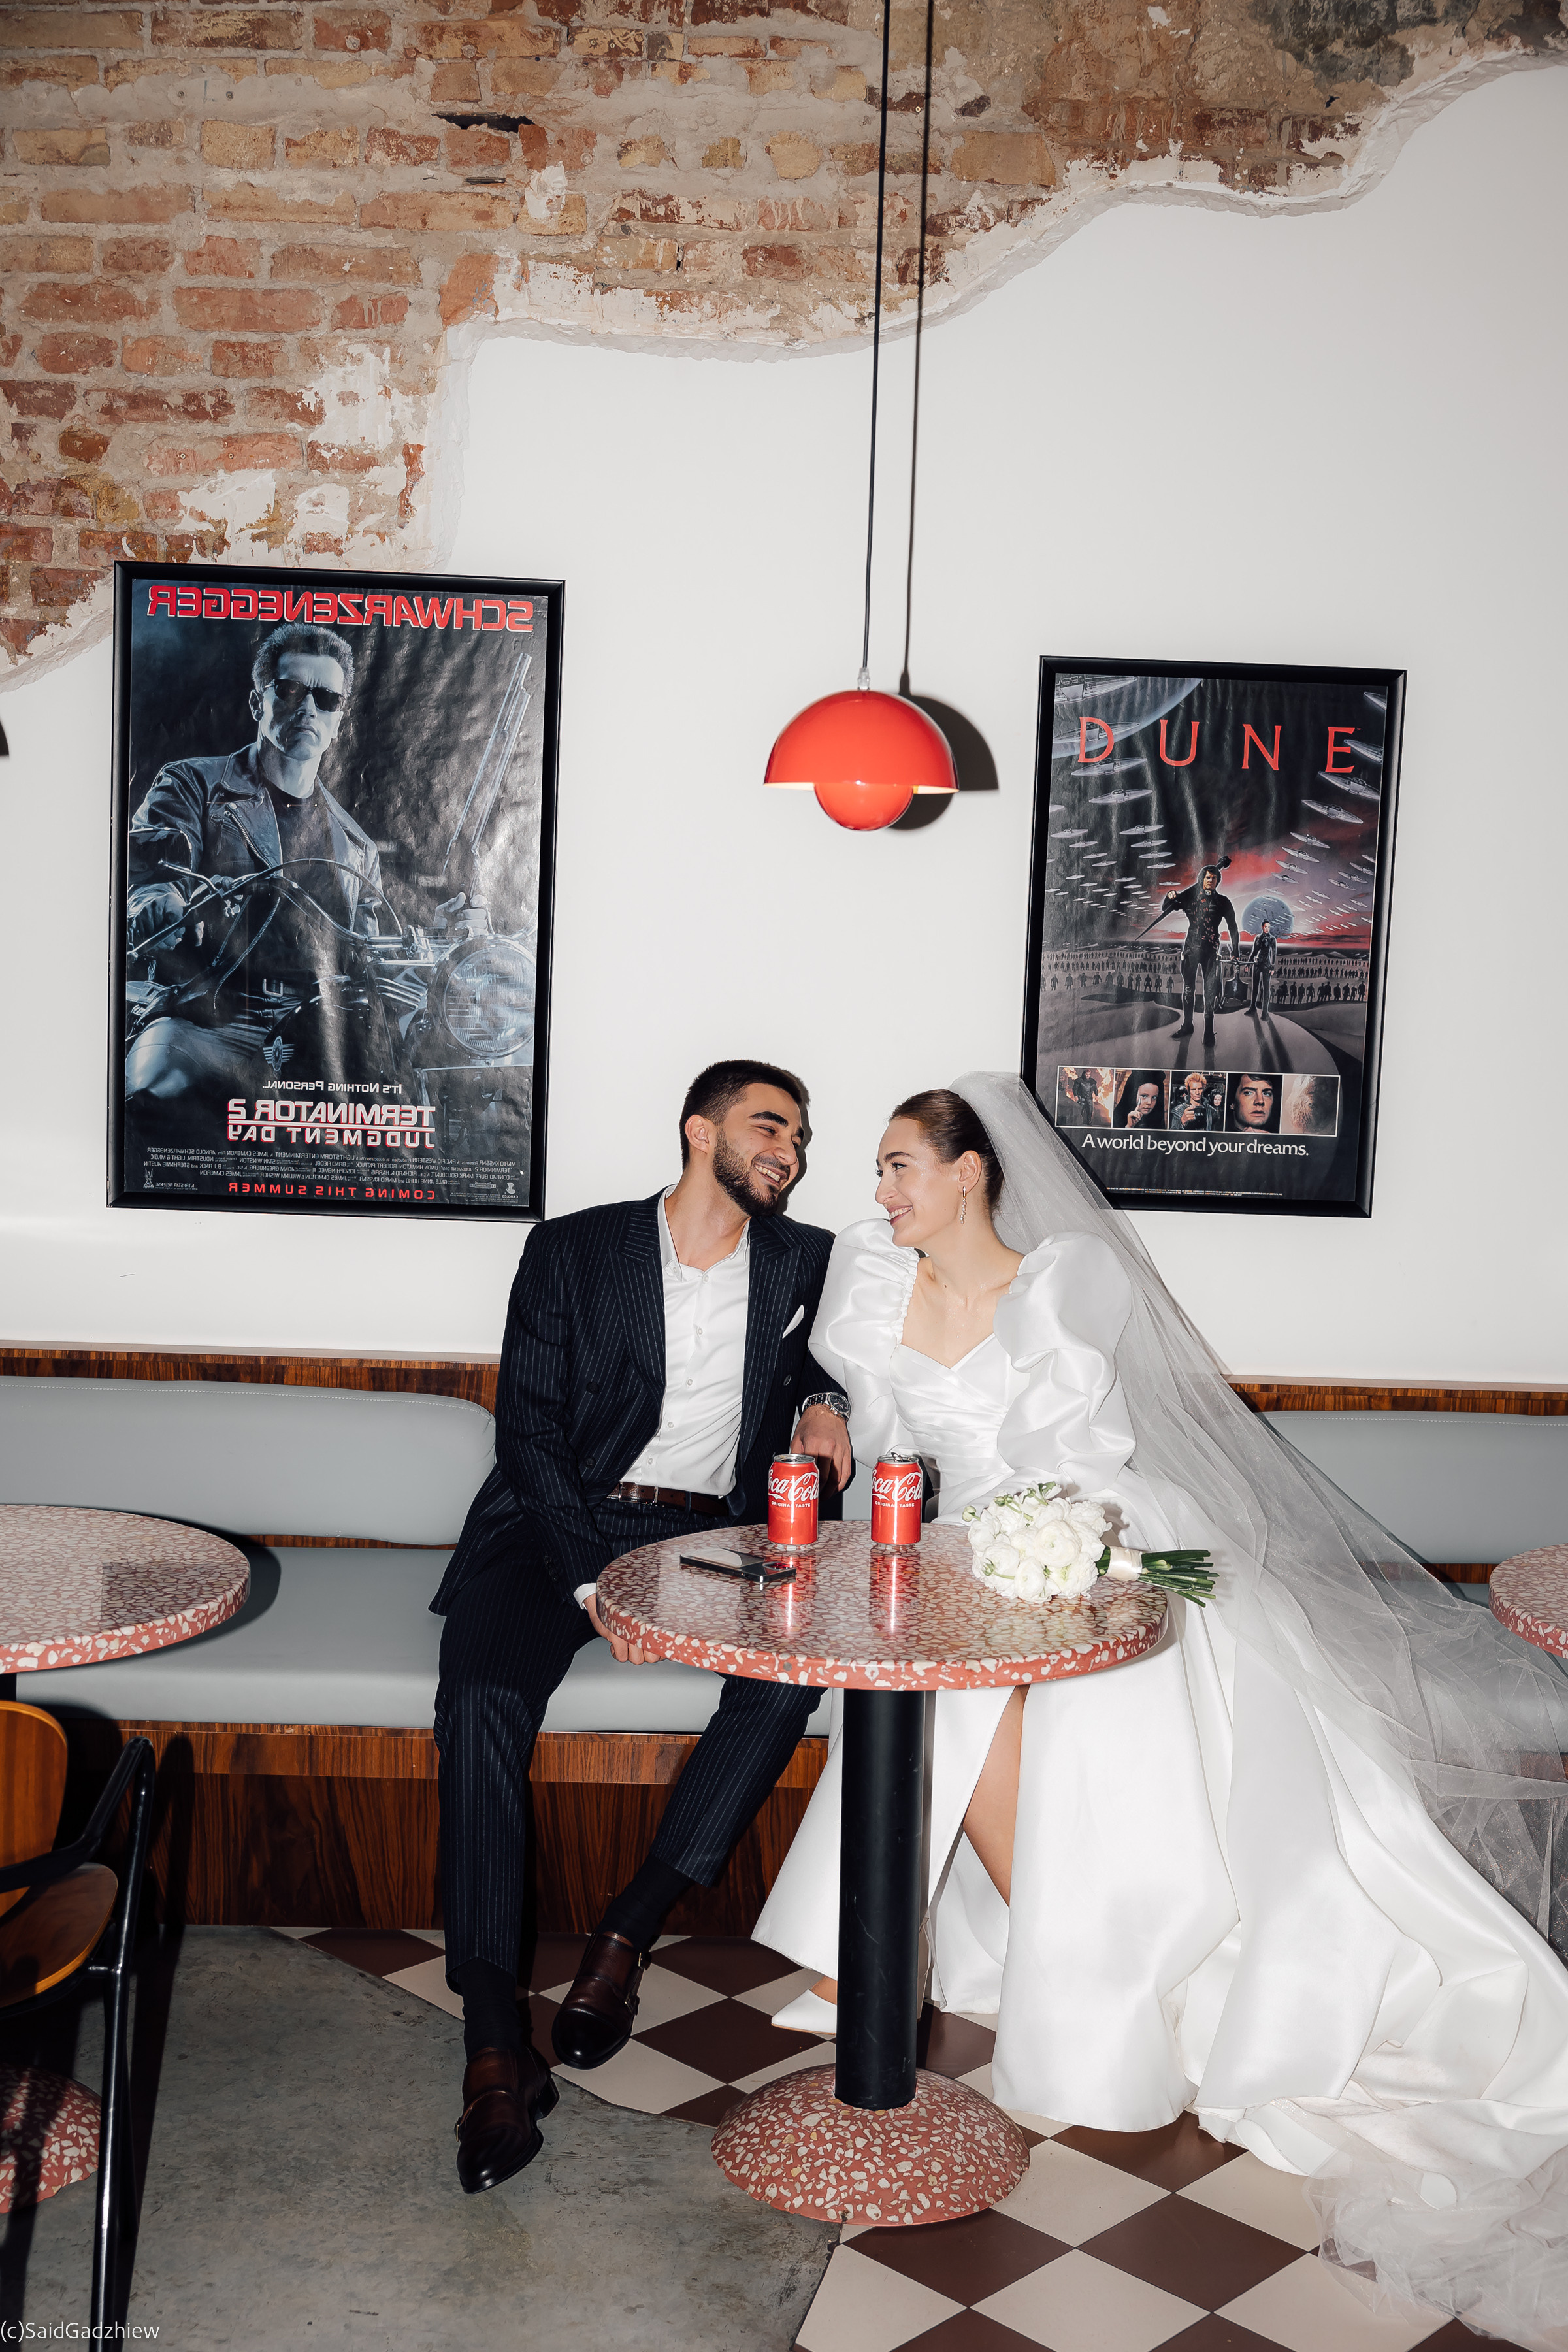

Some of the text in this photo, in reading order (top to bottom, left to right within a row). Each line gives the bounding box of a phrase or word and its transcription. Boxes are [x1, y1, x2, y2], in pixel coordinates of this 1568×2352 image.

[1077, 717, 1355, 773] DUNE
[1082, 1134, 1309, 1156] A world beyond your dreams.
